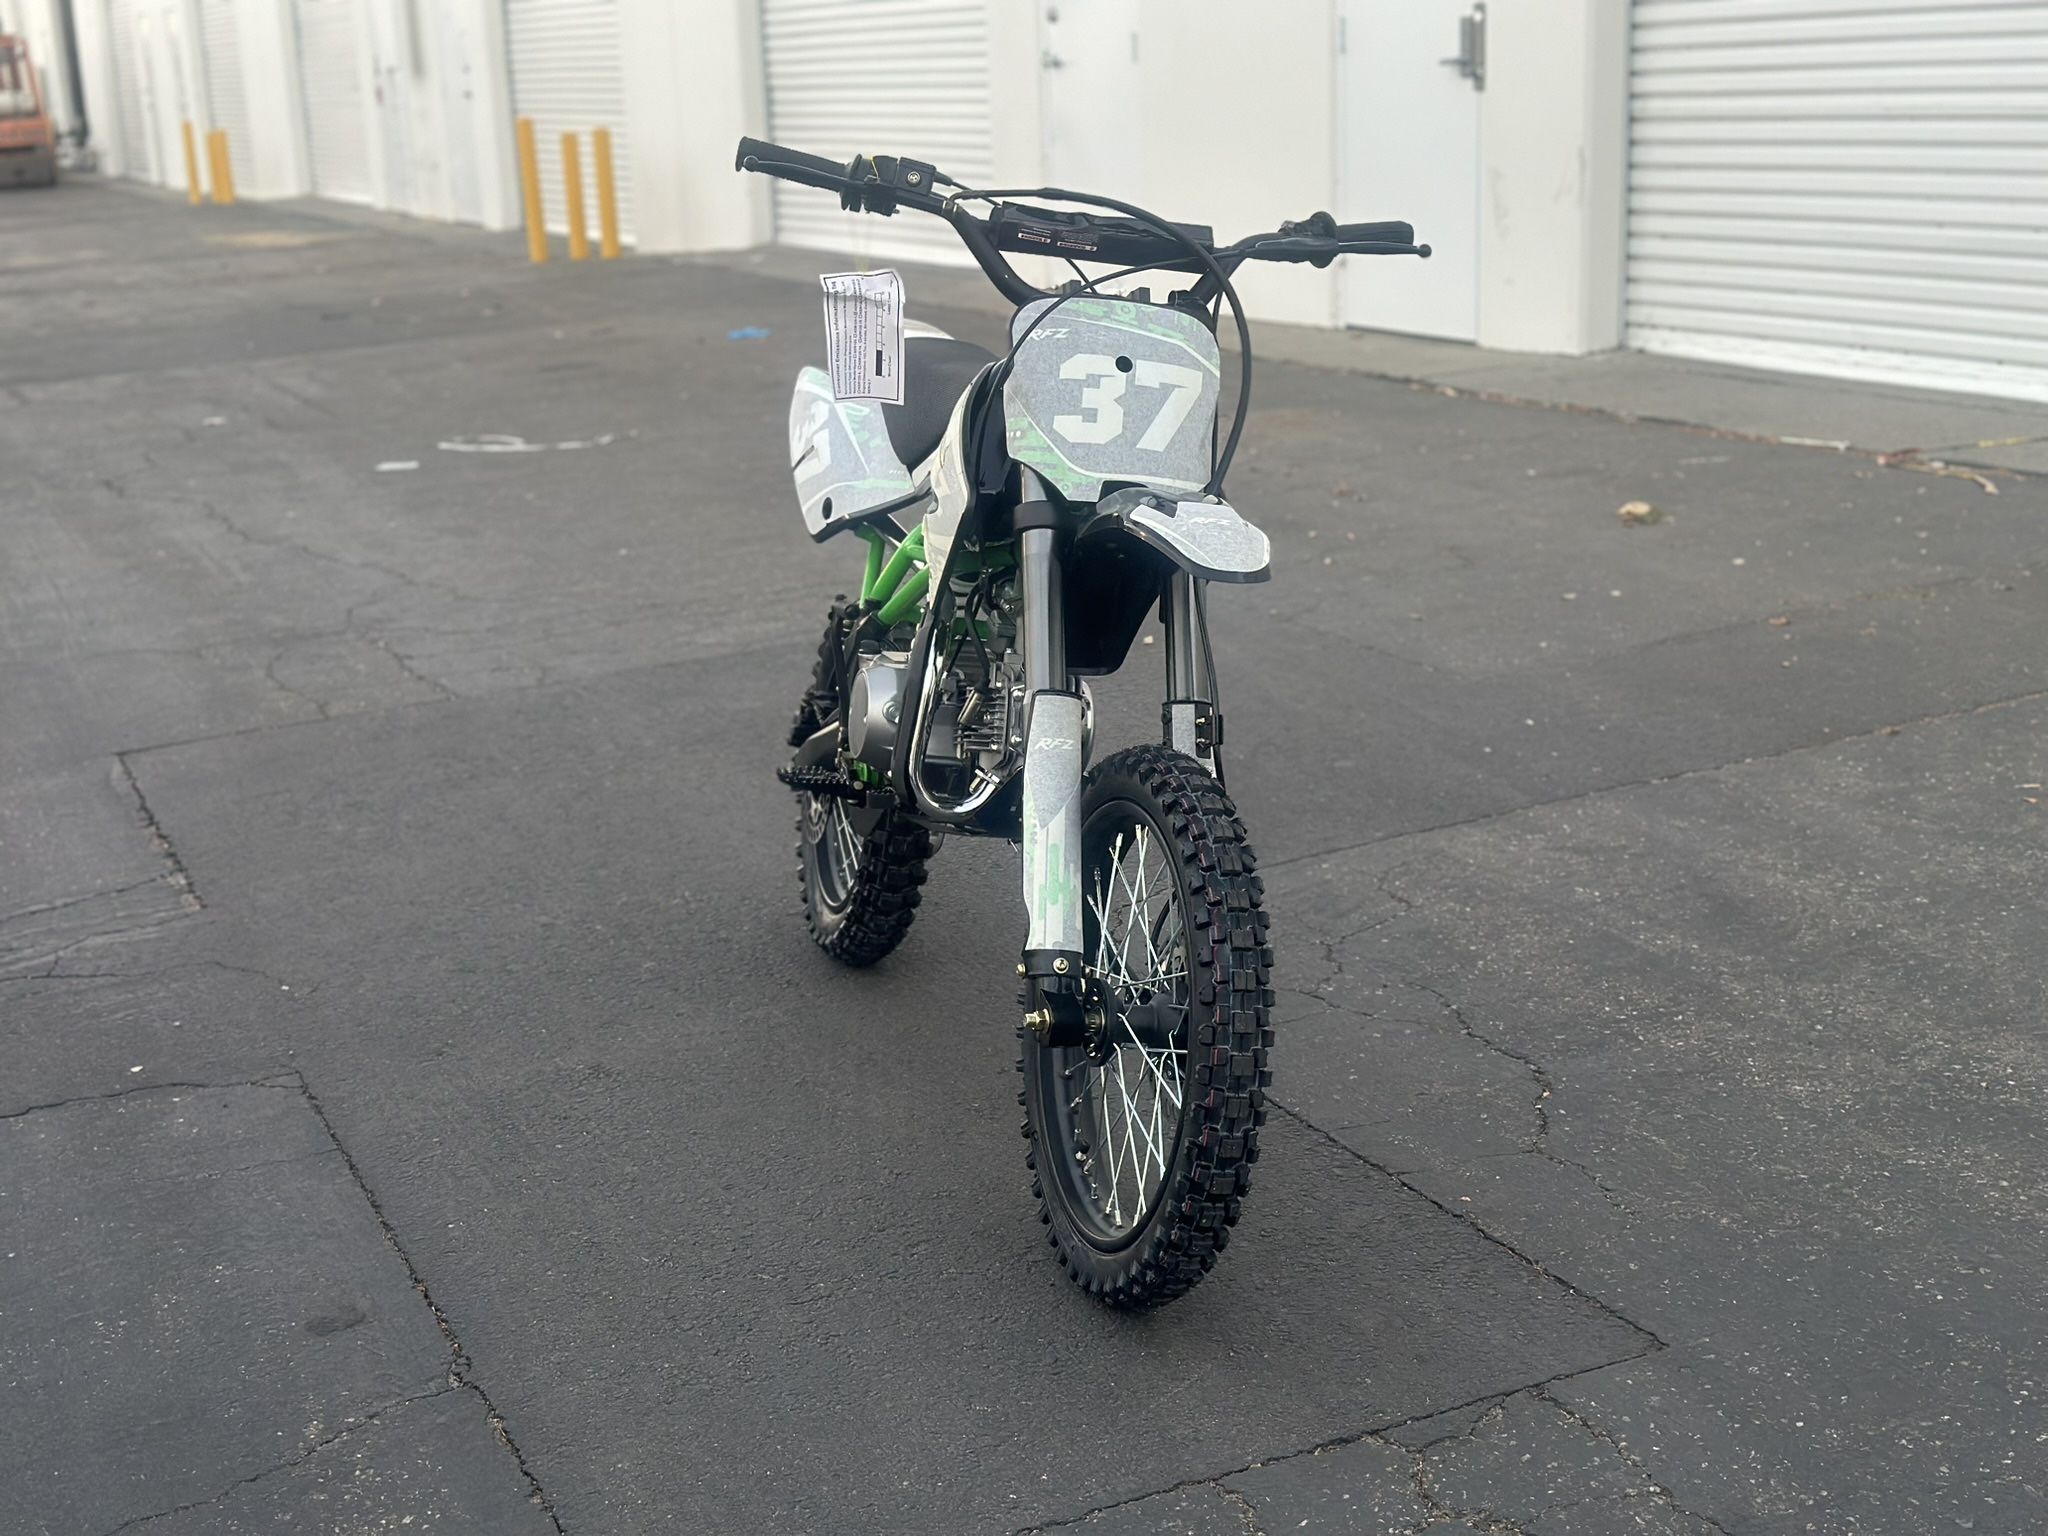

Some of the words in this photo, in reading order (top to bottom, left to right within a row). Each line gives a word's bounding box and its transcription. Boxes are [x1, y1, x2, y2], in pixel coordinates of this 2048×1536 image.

[1026, 328, 1070, 341] RFZ
[1052, 353, 1203, 452] 37
[1034, 737, 1074, 750] RFZ
